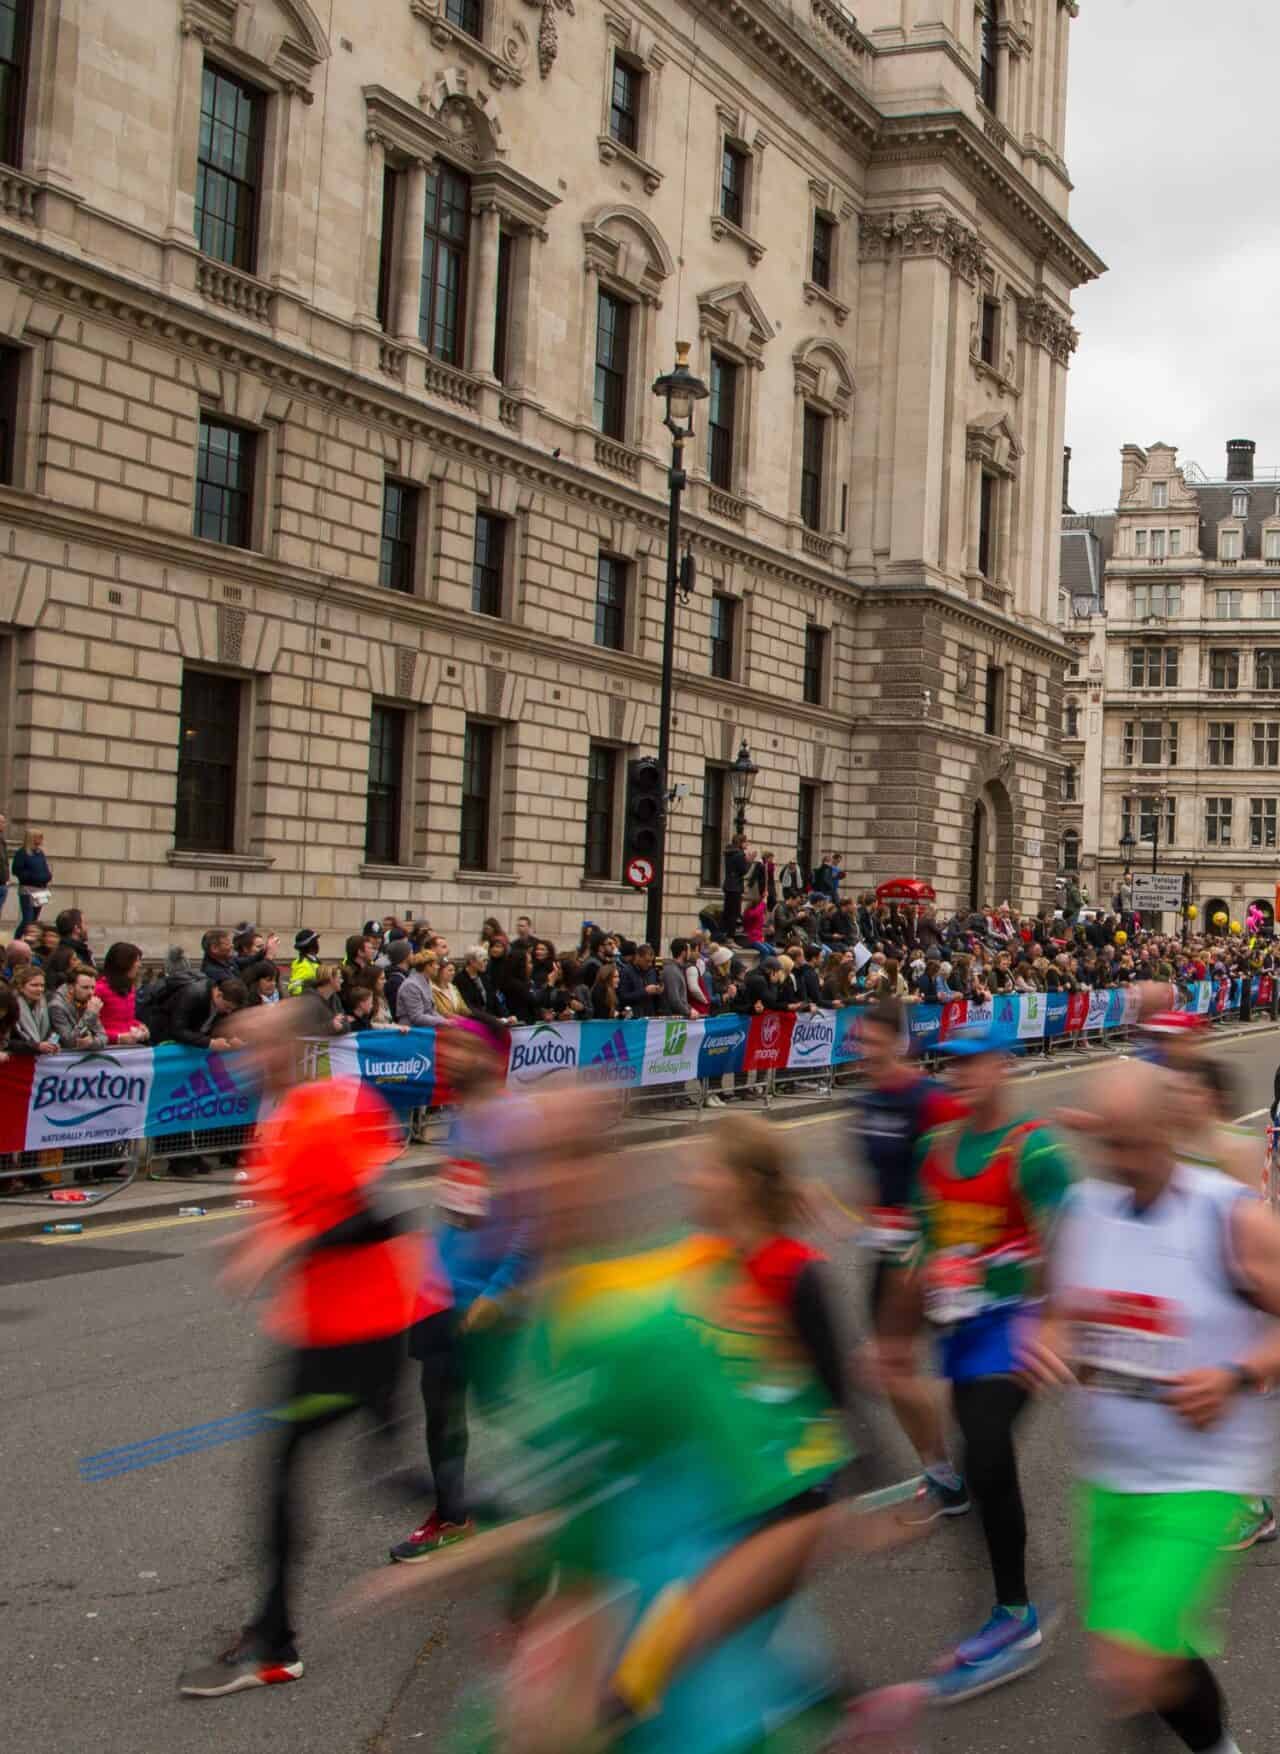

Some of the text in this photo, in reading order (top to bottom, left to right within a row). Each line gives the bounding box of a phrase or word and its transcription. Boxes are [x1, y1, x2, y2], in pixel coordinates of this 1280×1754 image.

[793, 1023, 833, 1043] Buxton
[510, 1040, 576, 1072] Buxton
[754, 1048, 779, 1061] money
[365, 1057, 420, 1076] Lucozade
[33, 1070, 146, 1111] Buxton
[157, 1094, 249, 1123] adidas
[41, 1130, 83, 1143] NATURALLY
[85, 1128, 115, 1141] PUMPED
